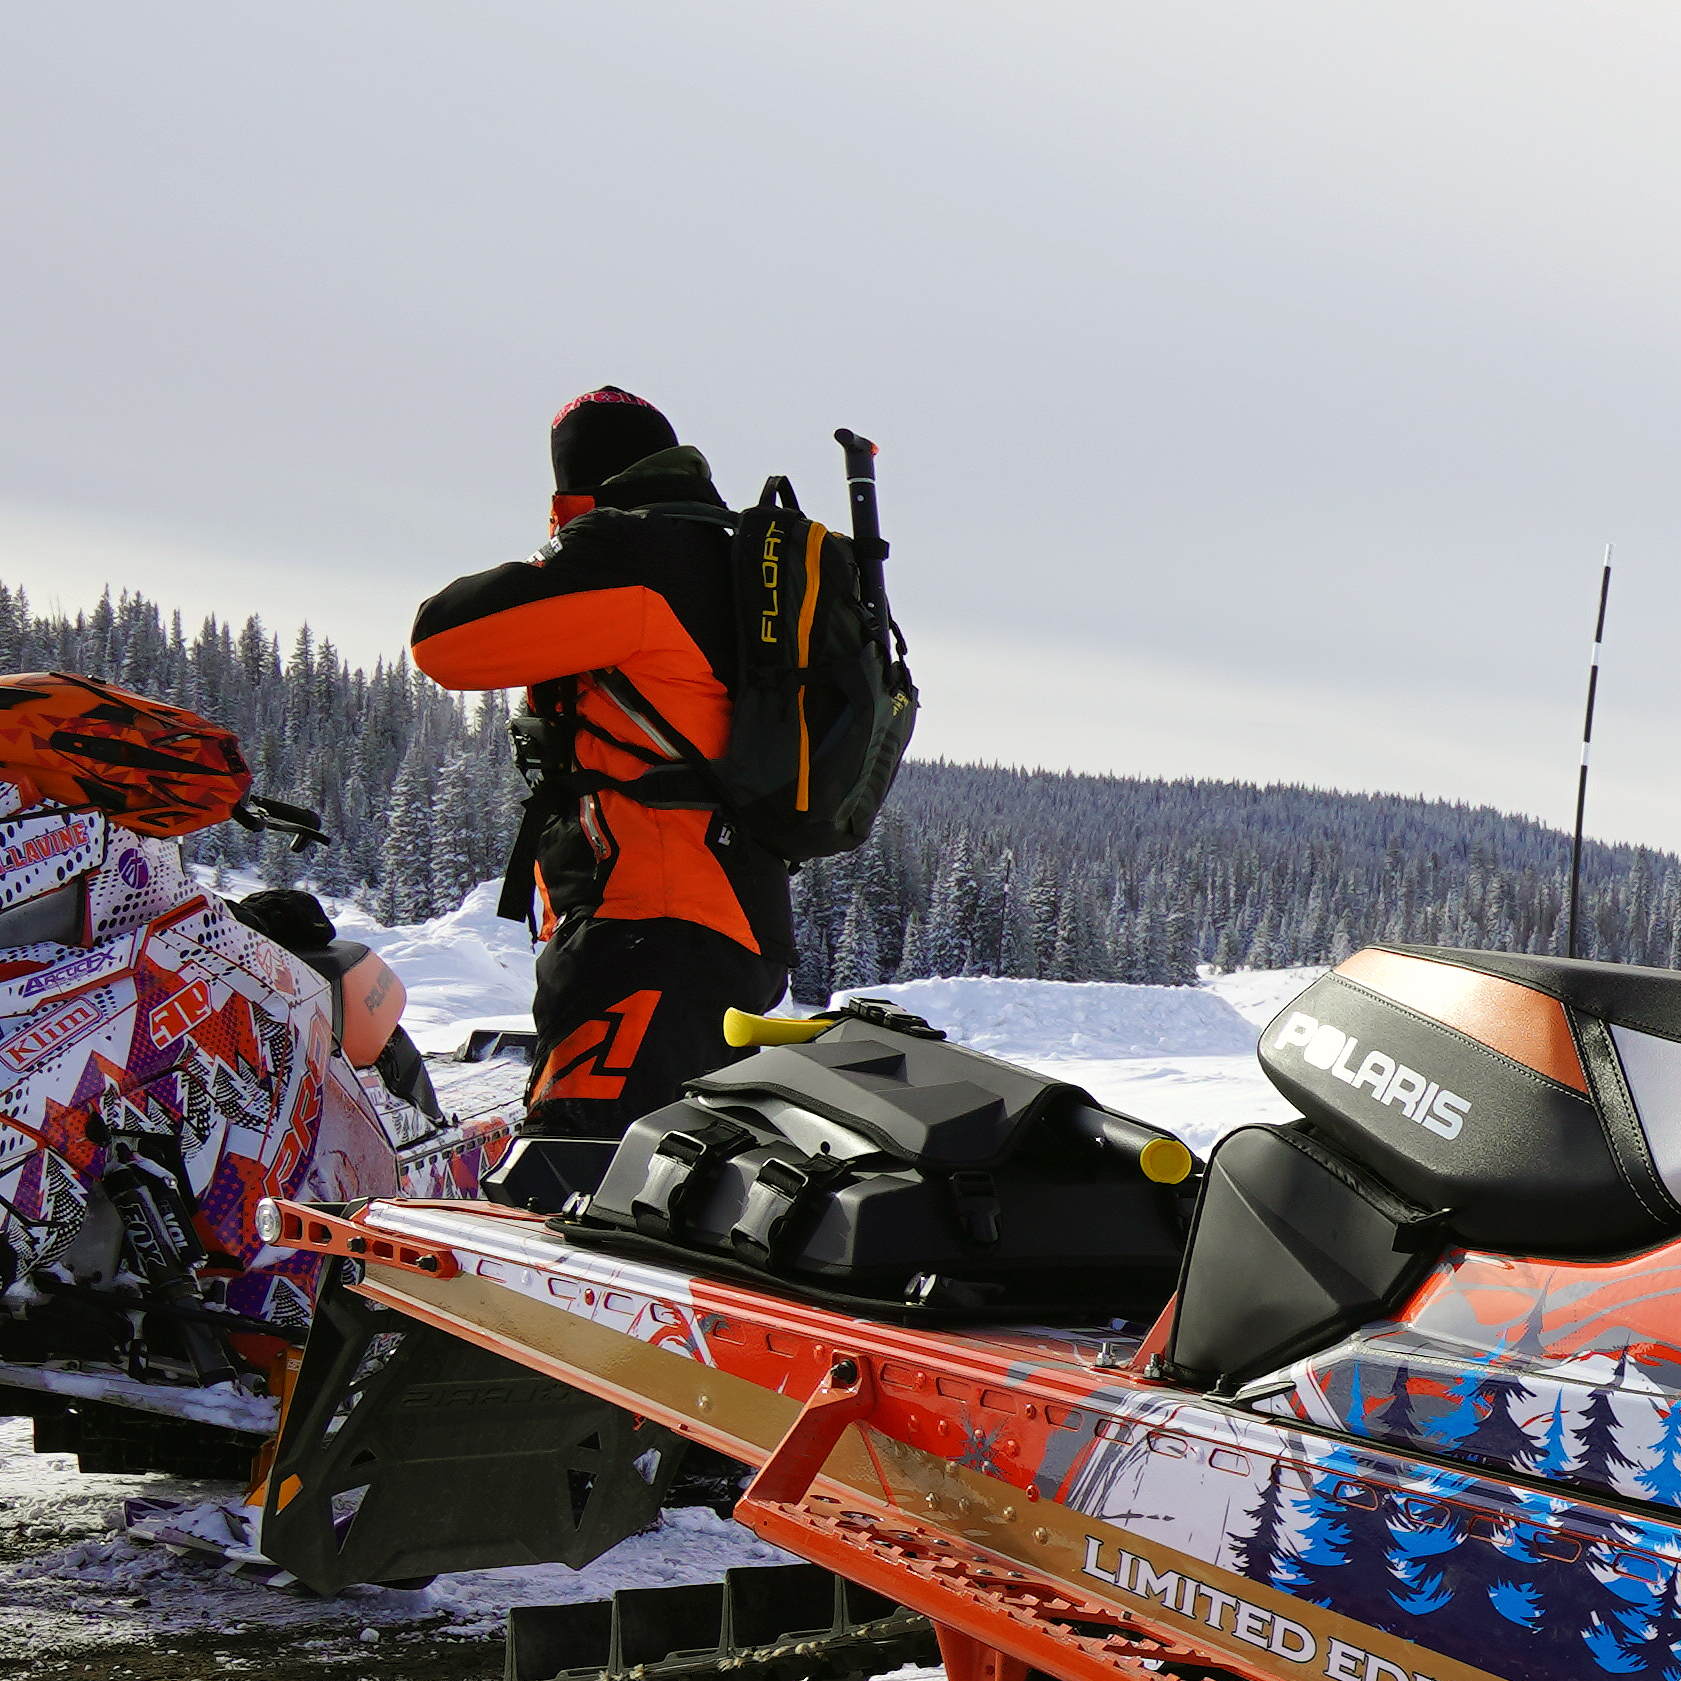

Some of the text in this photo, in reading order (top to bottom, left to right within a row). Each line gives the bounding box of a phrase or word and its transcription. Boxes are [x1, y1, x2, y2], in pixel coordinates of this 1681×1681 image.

[761, 521, 785, 643] FLOAT
[1274, 1010, 1472, 1141] POLARIS
[1082, 1534, 1318, 1665] LIMITED
